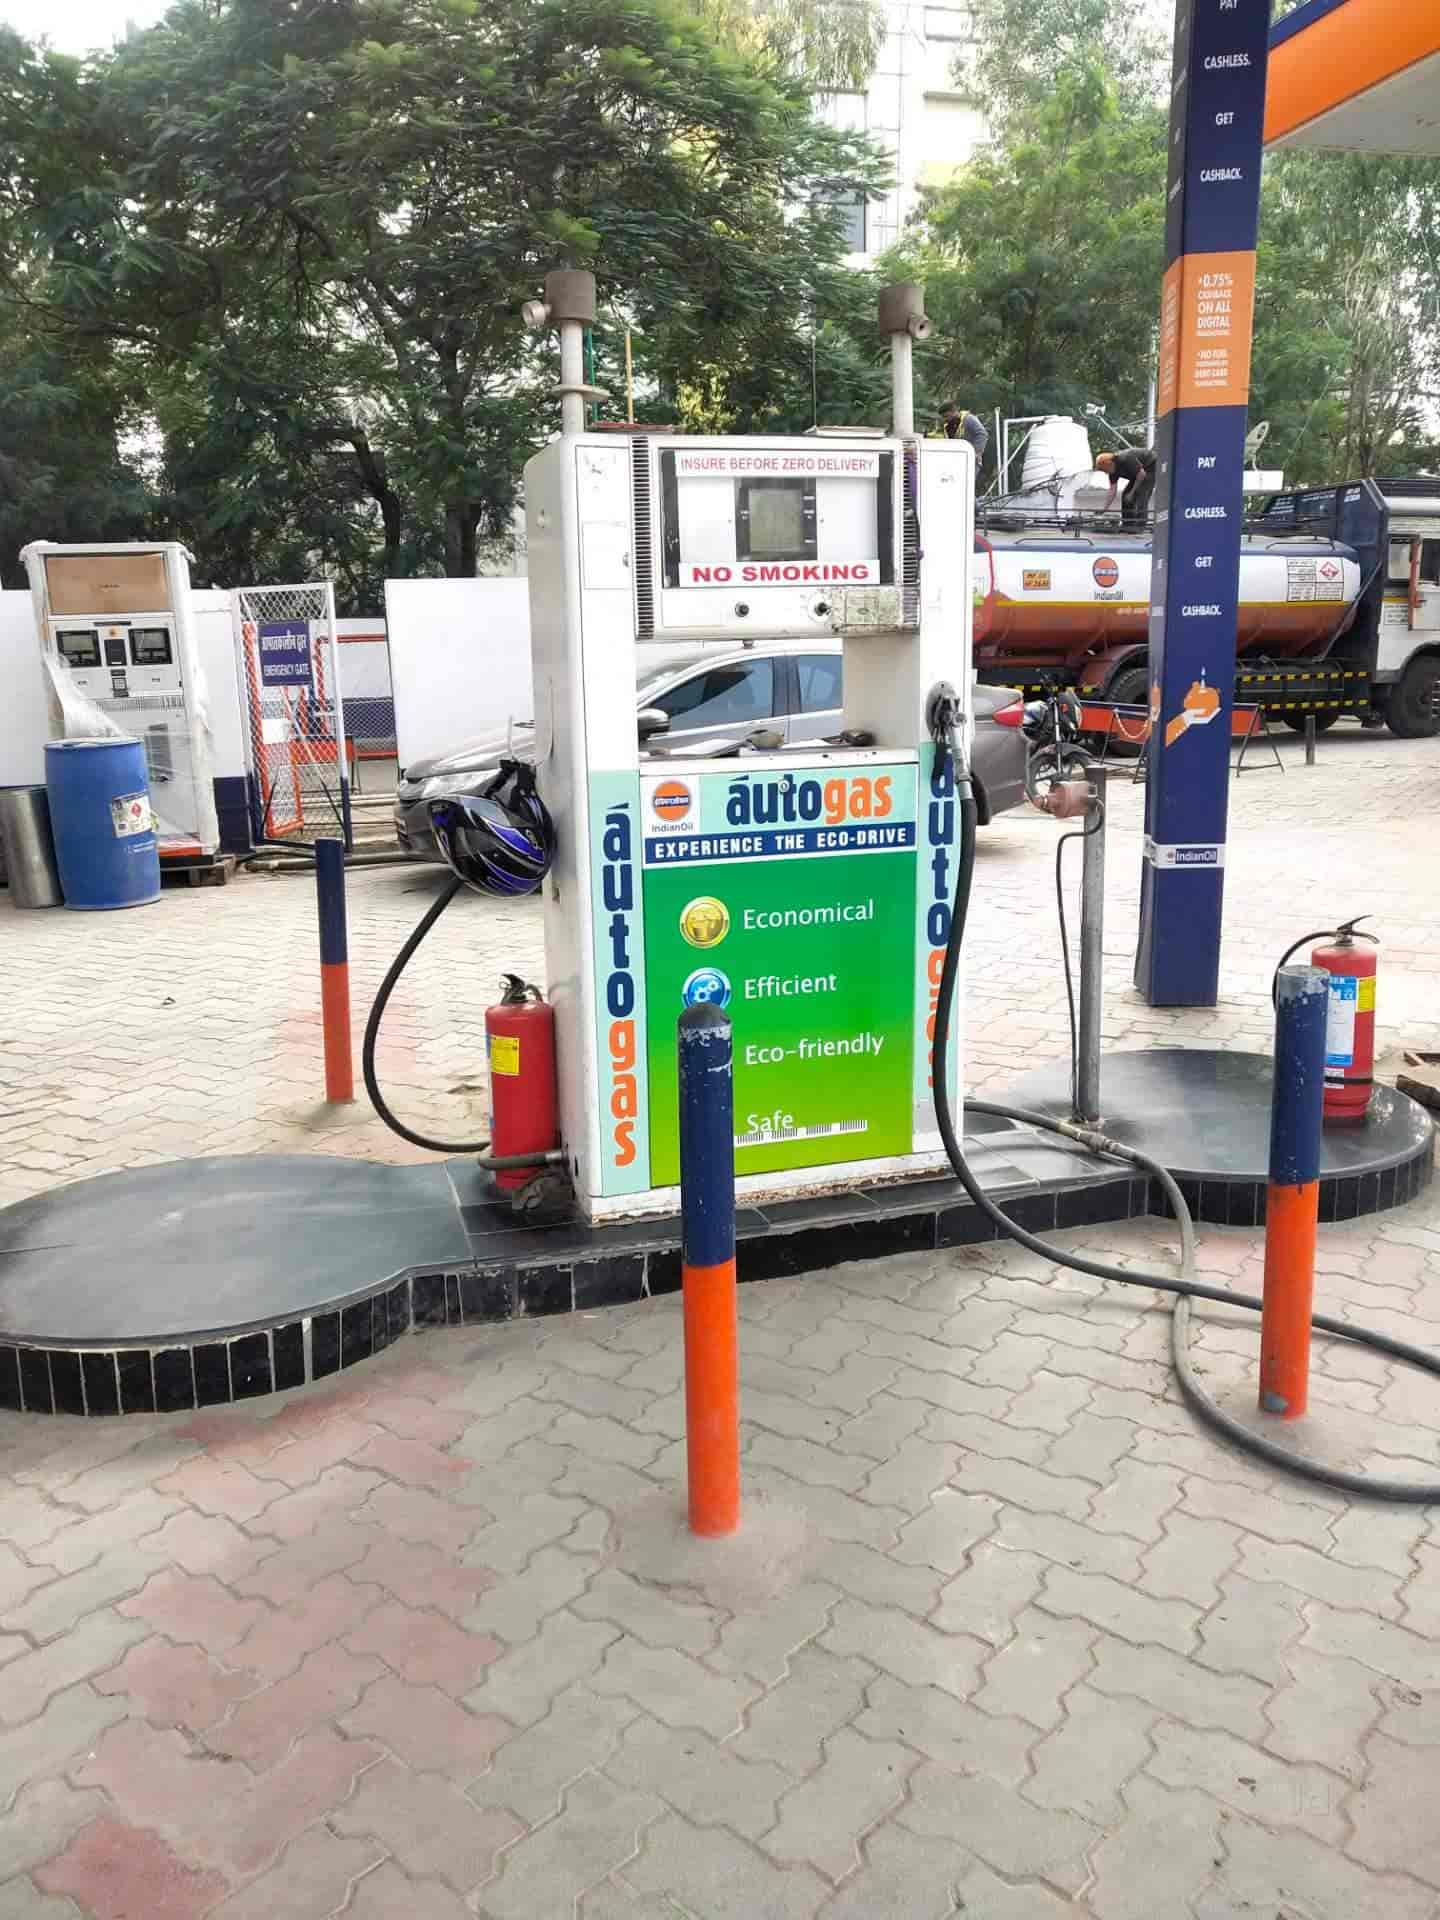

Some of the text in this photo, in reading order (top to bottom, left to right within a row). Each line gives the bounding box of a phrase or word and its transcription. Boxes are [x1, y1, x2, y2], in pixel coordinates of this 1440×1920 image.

[1215, 112, 1234, 126] GET
[681, 458, 874, 471] INSURE BEFORE ZERO DELIVERY
[1197, 456, 1216, 469] PAY
[1195, 556, 1213, 568] GET
[693, 564, 870, 582] NO SMOKING
[651, 822, 694, 834] IndianOil
[655, 827, 907, 859] EXPERIENCE THE ECO-DRIVE
[743, 899, 874, 929] Economical
[744, 973, 838, 1000] Efficient
[745, 1032, 885, 1065] Eco-friendly
[747, 1109, 793, 1134] Safe
